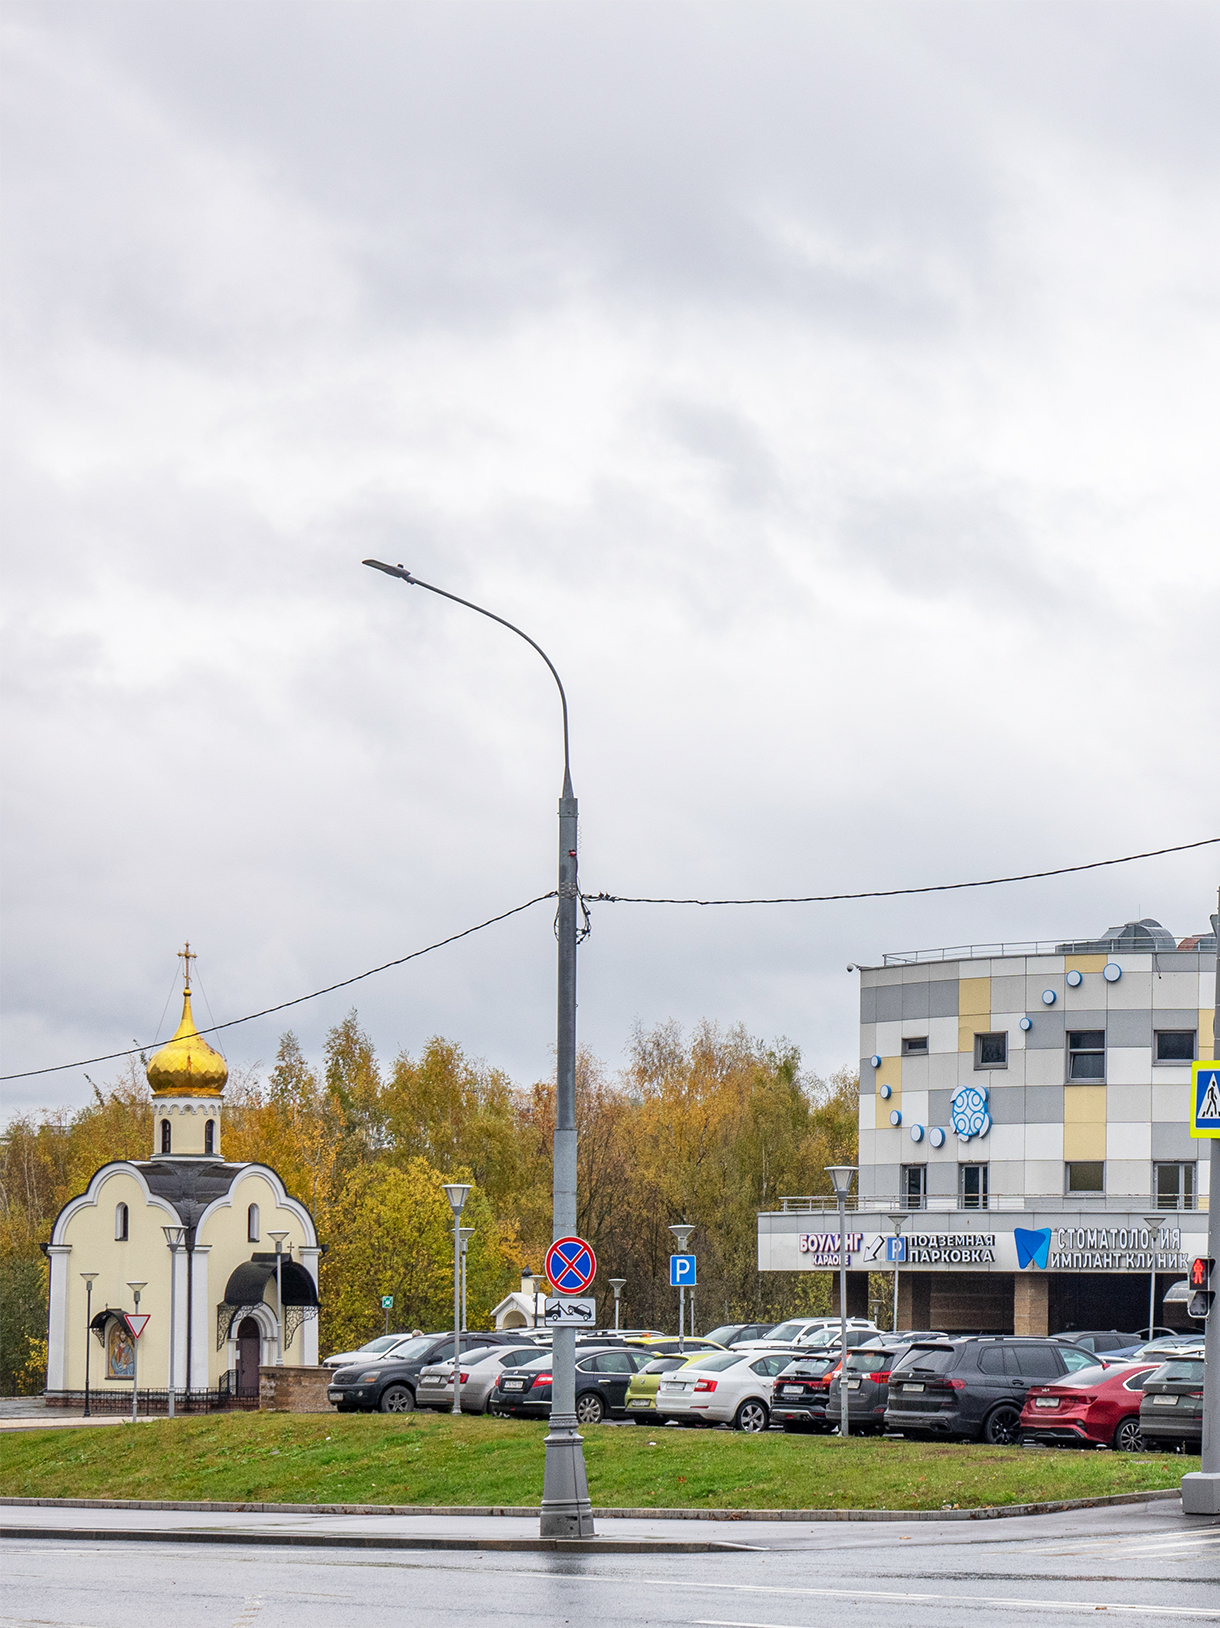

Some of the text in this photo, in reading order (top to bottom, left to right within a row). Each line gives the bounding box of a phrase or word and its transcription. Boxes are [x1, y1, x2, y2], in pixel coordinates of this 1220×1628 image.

[799, 1233, 863, 1253] БОУЛИНГ
[909, 1234, 996, 1248] ПОДЗЕМНАЯ
[909, 1249, 996, 1263] ПАРКОВКА
[1051, 1252, 1122, 1269] ИМПЛАНТ
